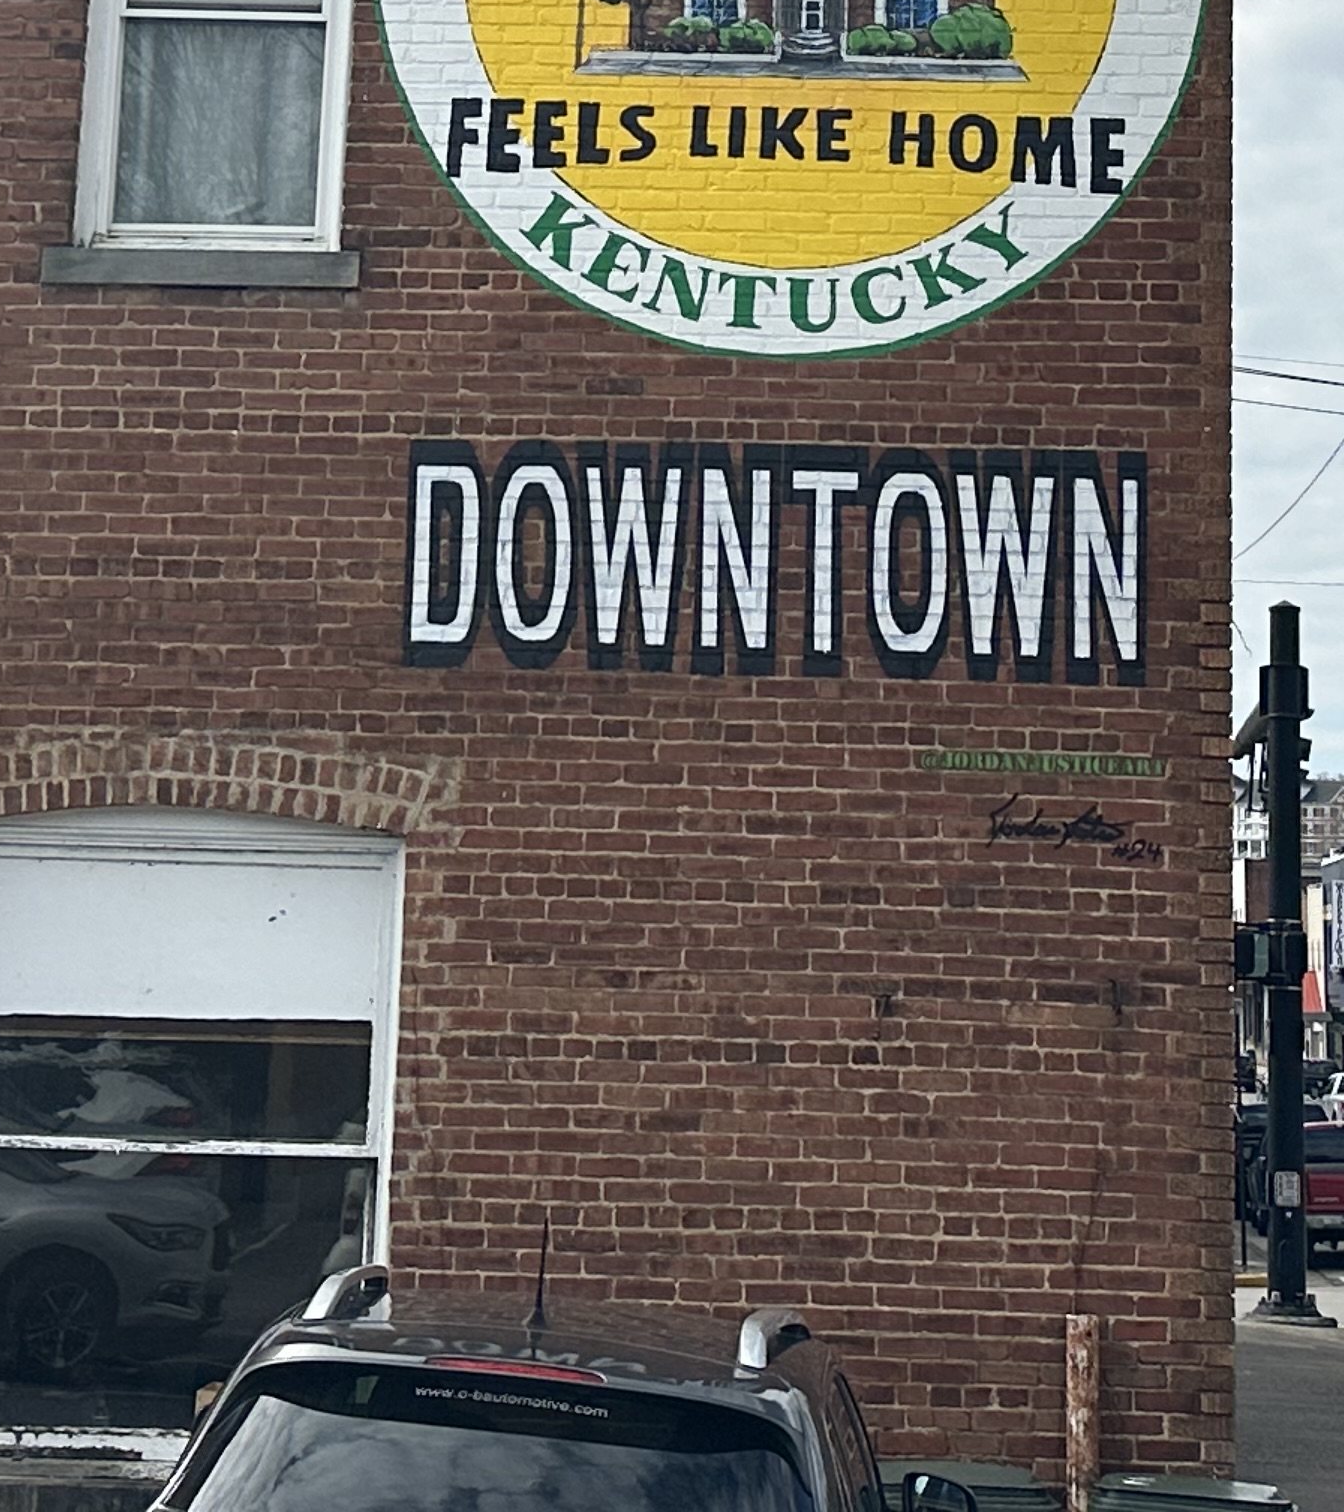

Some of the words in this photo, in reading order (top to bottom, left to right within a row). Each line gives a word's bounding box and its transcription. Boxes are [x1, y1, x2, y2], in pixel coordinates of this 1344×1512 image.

[446, 97, 657, 178] FEELS
[689, 105, 853, 163] LIKE
[888, 110, 1126, 195] HOME
[519, 190, 1029, 334] KENTUCKY
[409, 463, 1140, 663] DOWNTOWN
